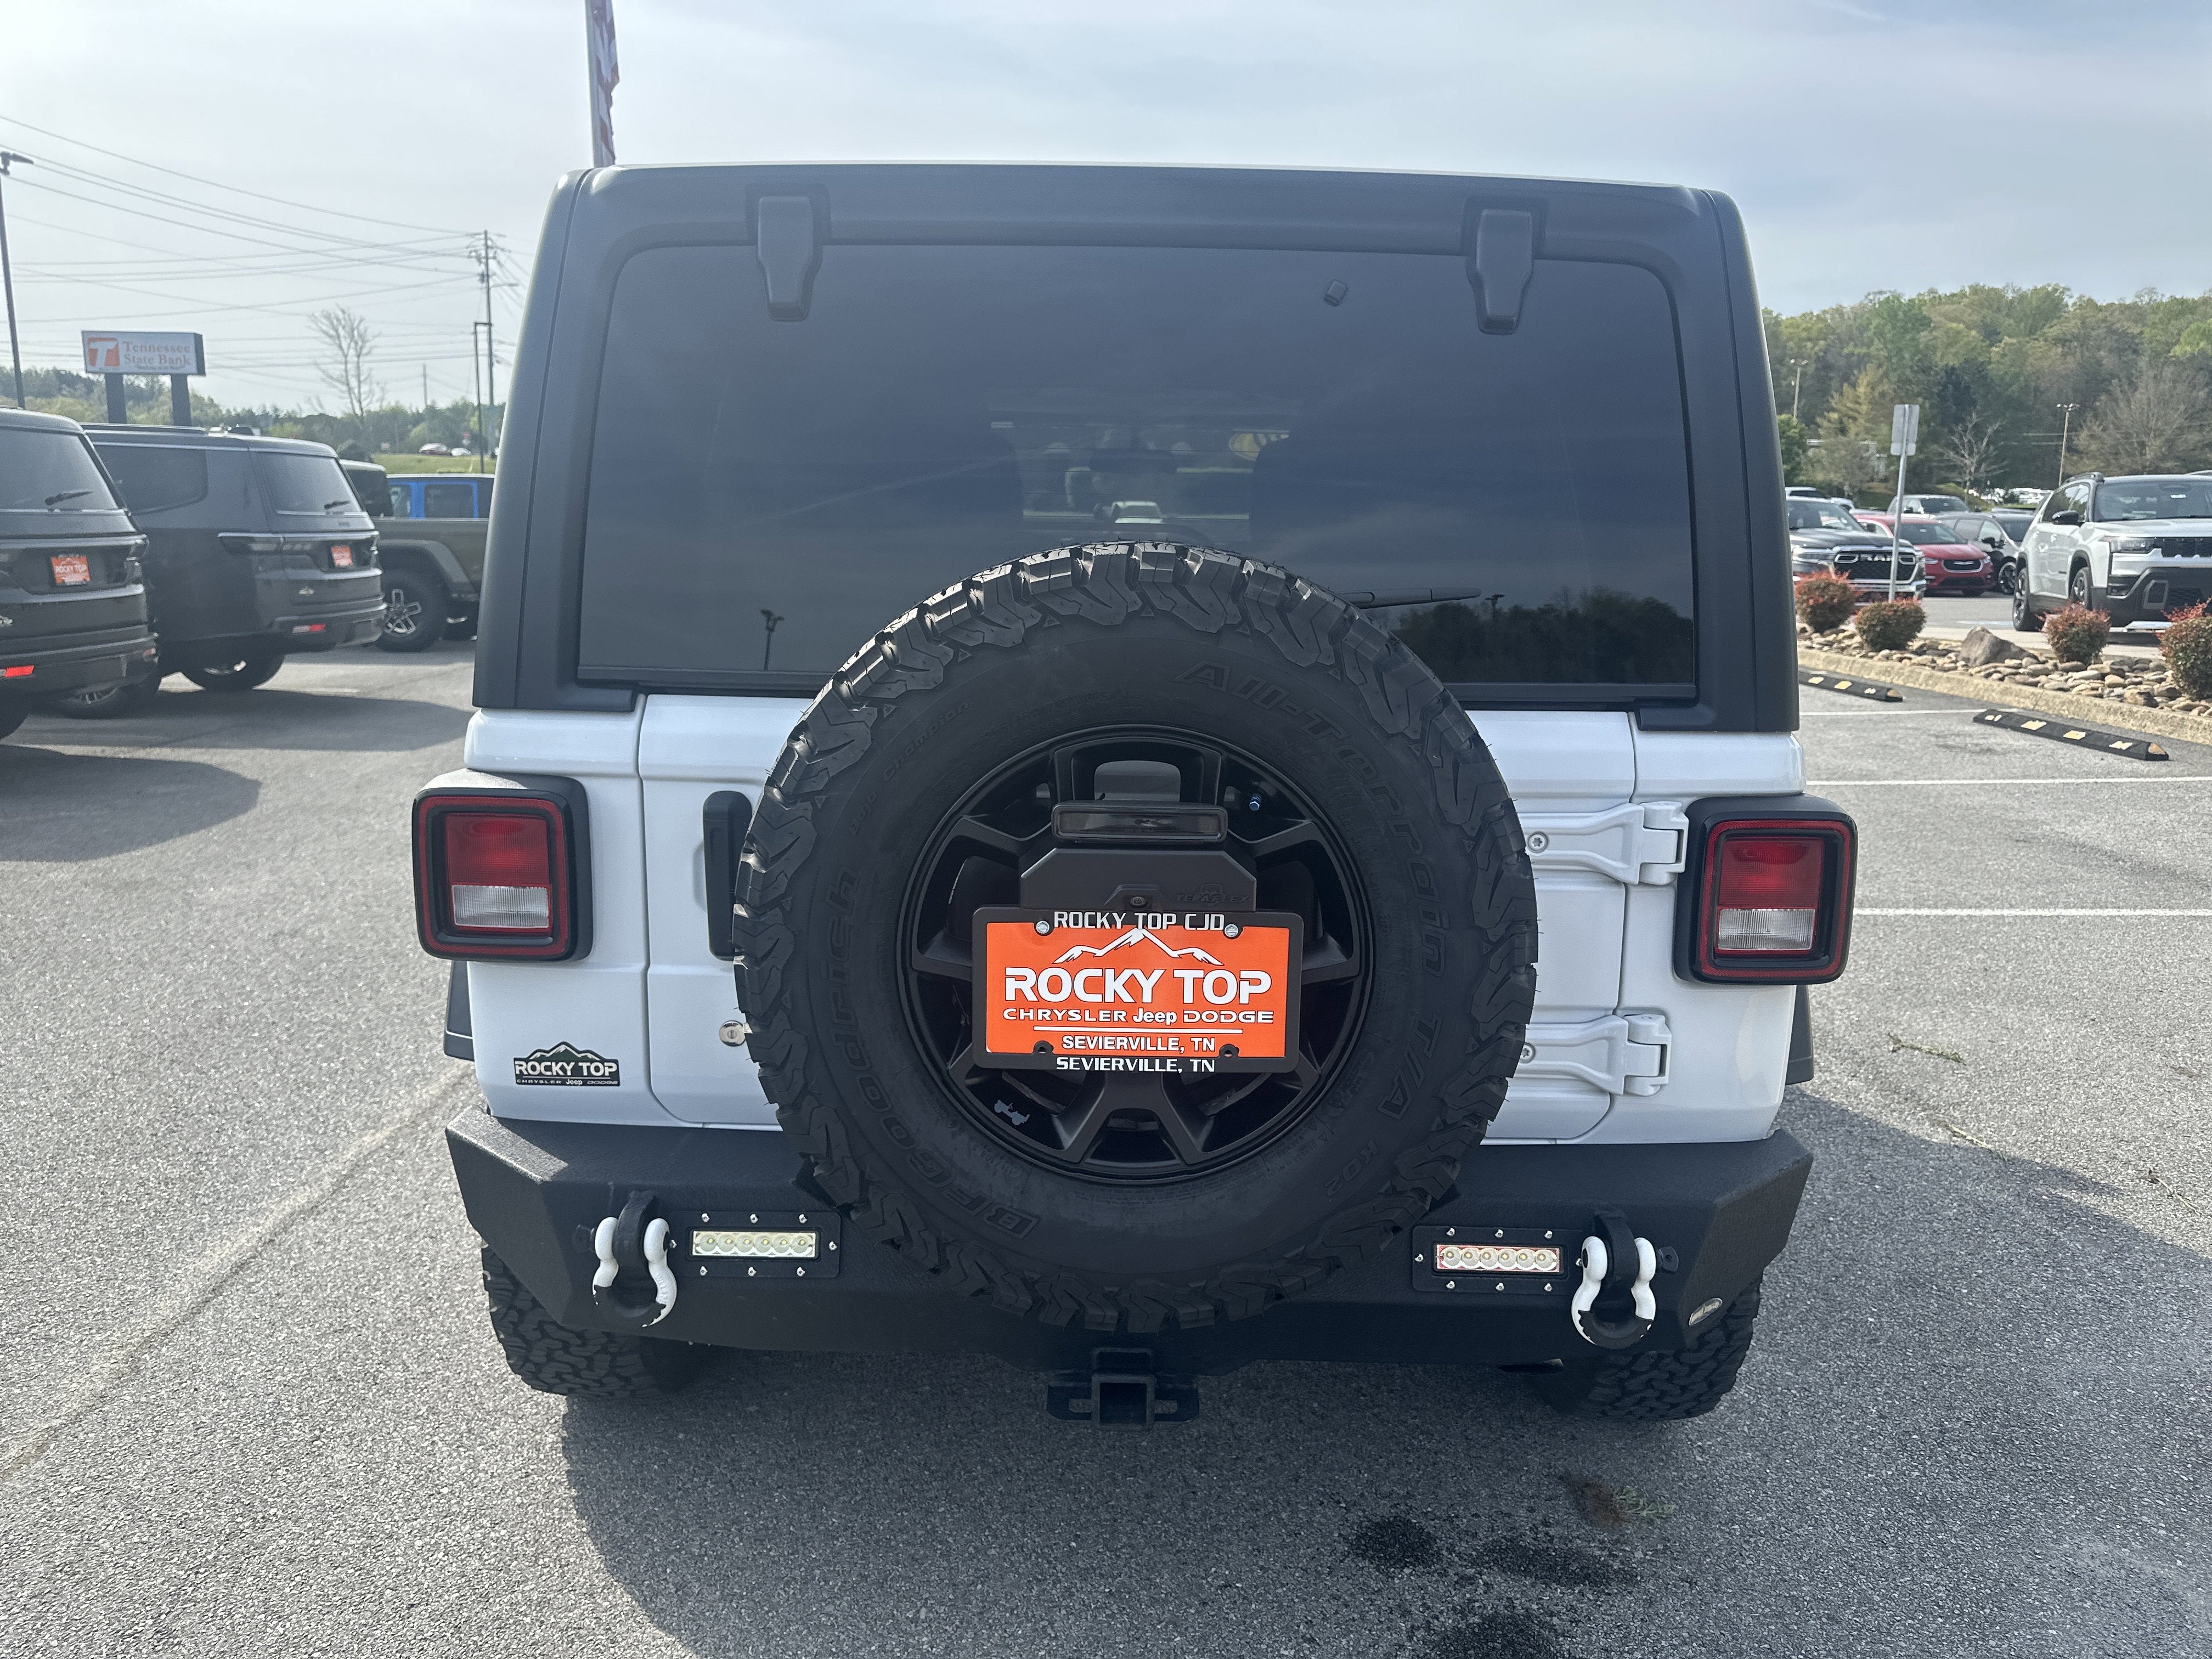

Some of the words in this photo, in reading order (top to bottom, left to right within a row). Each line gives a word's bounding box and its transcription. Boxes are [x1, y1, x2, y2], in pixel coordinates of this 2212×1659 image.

[122, 341, 190, 352] Tennessee
[123, 354, 154, 365] State
[159, 354, 190, 366] Bank
[883, 701, 969, 781] Champion
[1054, 911, 1126, 929] ROCKY
[1135, 913, 1176, 930] TOP
[1185, 913, 1224, 931] CJD
[1005, 967, 1166, 1003] ROCKY
[1173, 969, 1272, 1005] TOP
[1002, 1008, 1127, 1022] CHRYSLER
[1132, 1008, 1177, 1025] Jeep
[1183, 1010, 1274, 1023] DODGE
[823, 866, 1040, 1238] BFGoodrich
[1062, 1035, 1184, 1054] SEVIERVILLE,
[1191, 1037, 1216, 1052] TN
[515, 1060, 575, 1076] ROCKY
[578, 1062, 617, 1076] TOP
[1056, 1057, 1183, 1073] SEVIERVILLE,
[1190, 1059, 1215, 1073] TN
[1377, 1013, 1443, 1120] T/A
[1325, 1139, 1379, 1197] KO2
